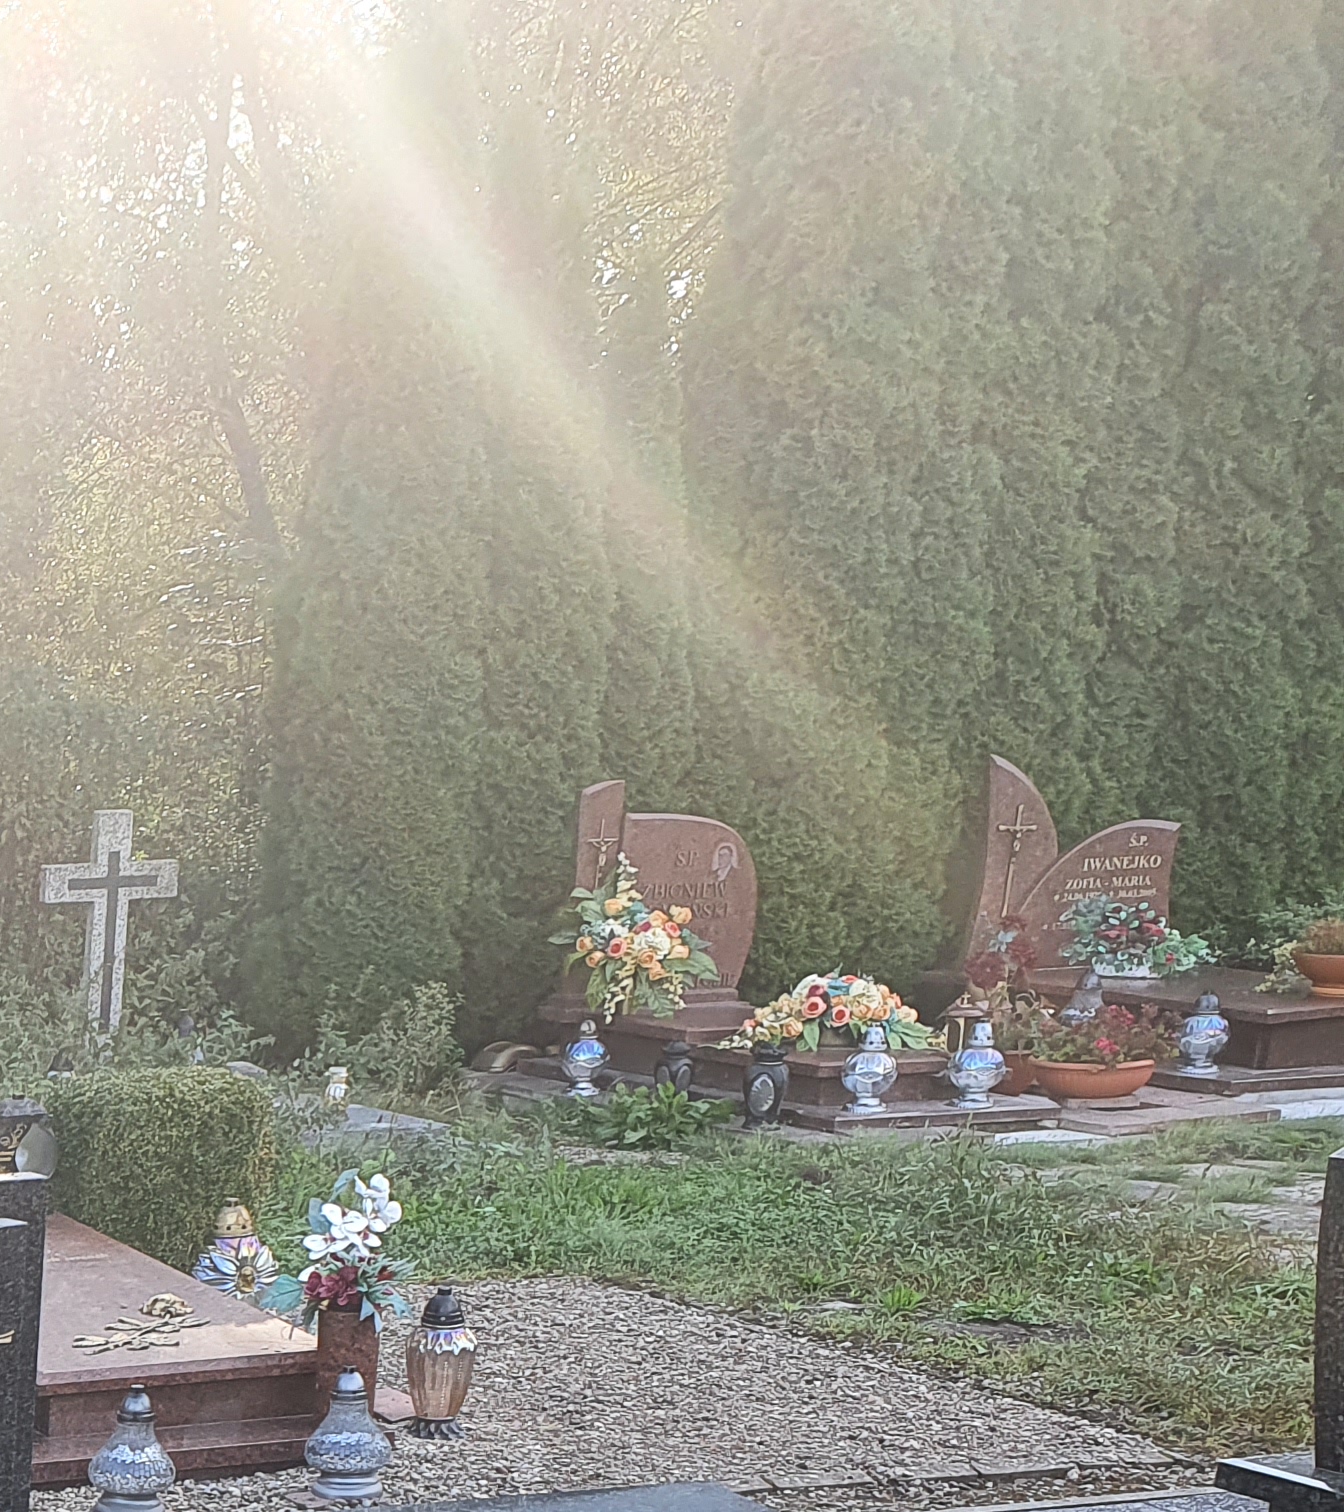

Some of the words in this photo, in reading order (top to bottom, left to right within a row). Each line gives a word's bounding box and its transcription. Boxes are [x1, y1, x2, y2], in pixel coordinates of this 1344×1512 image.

[1082, 854, 1162, 872] IWANEJKO
[1065, 877, 1102, 890] ZOFIA
[1111, 875, 1151, 887] MARIA
